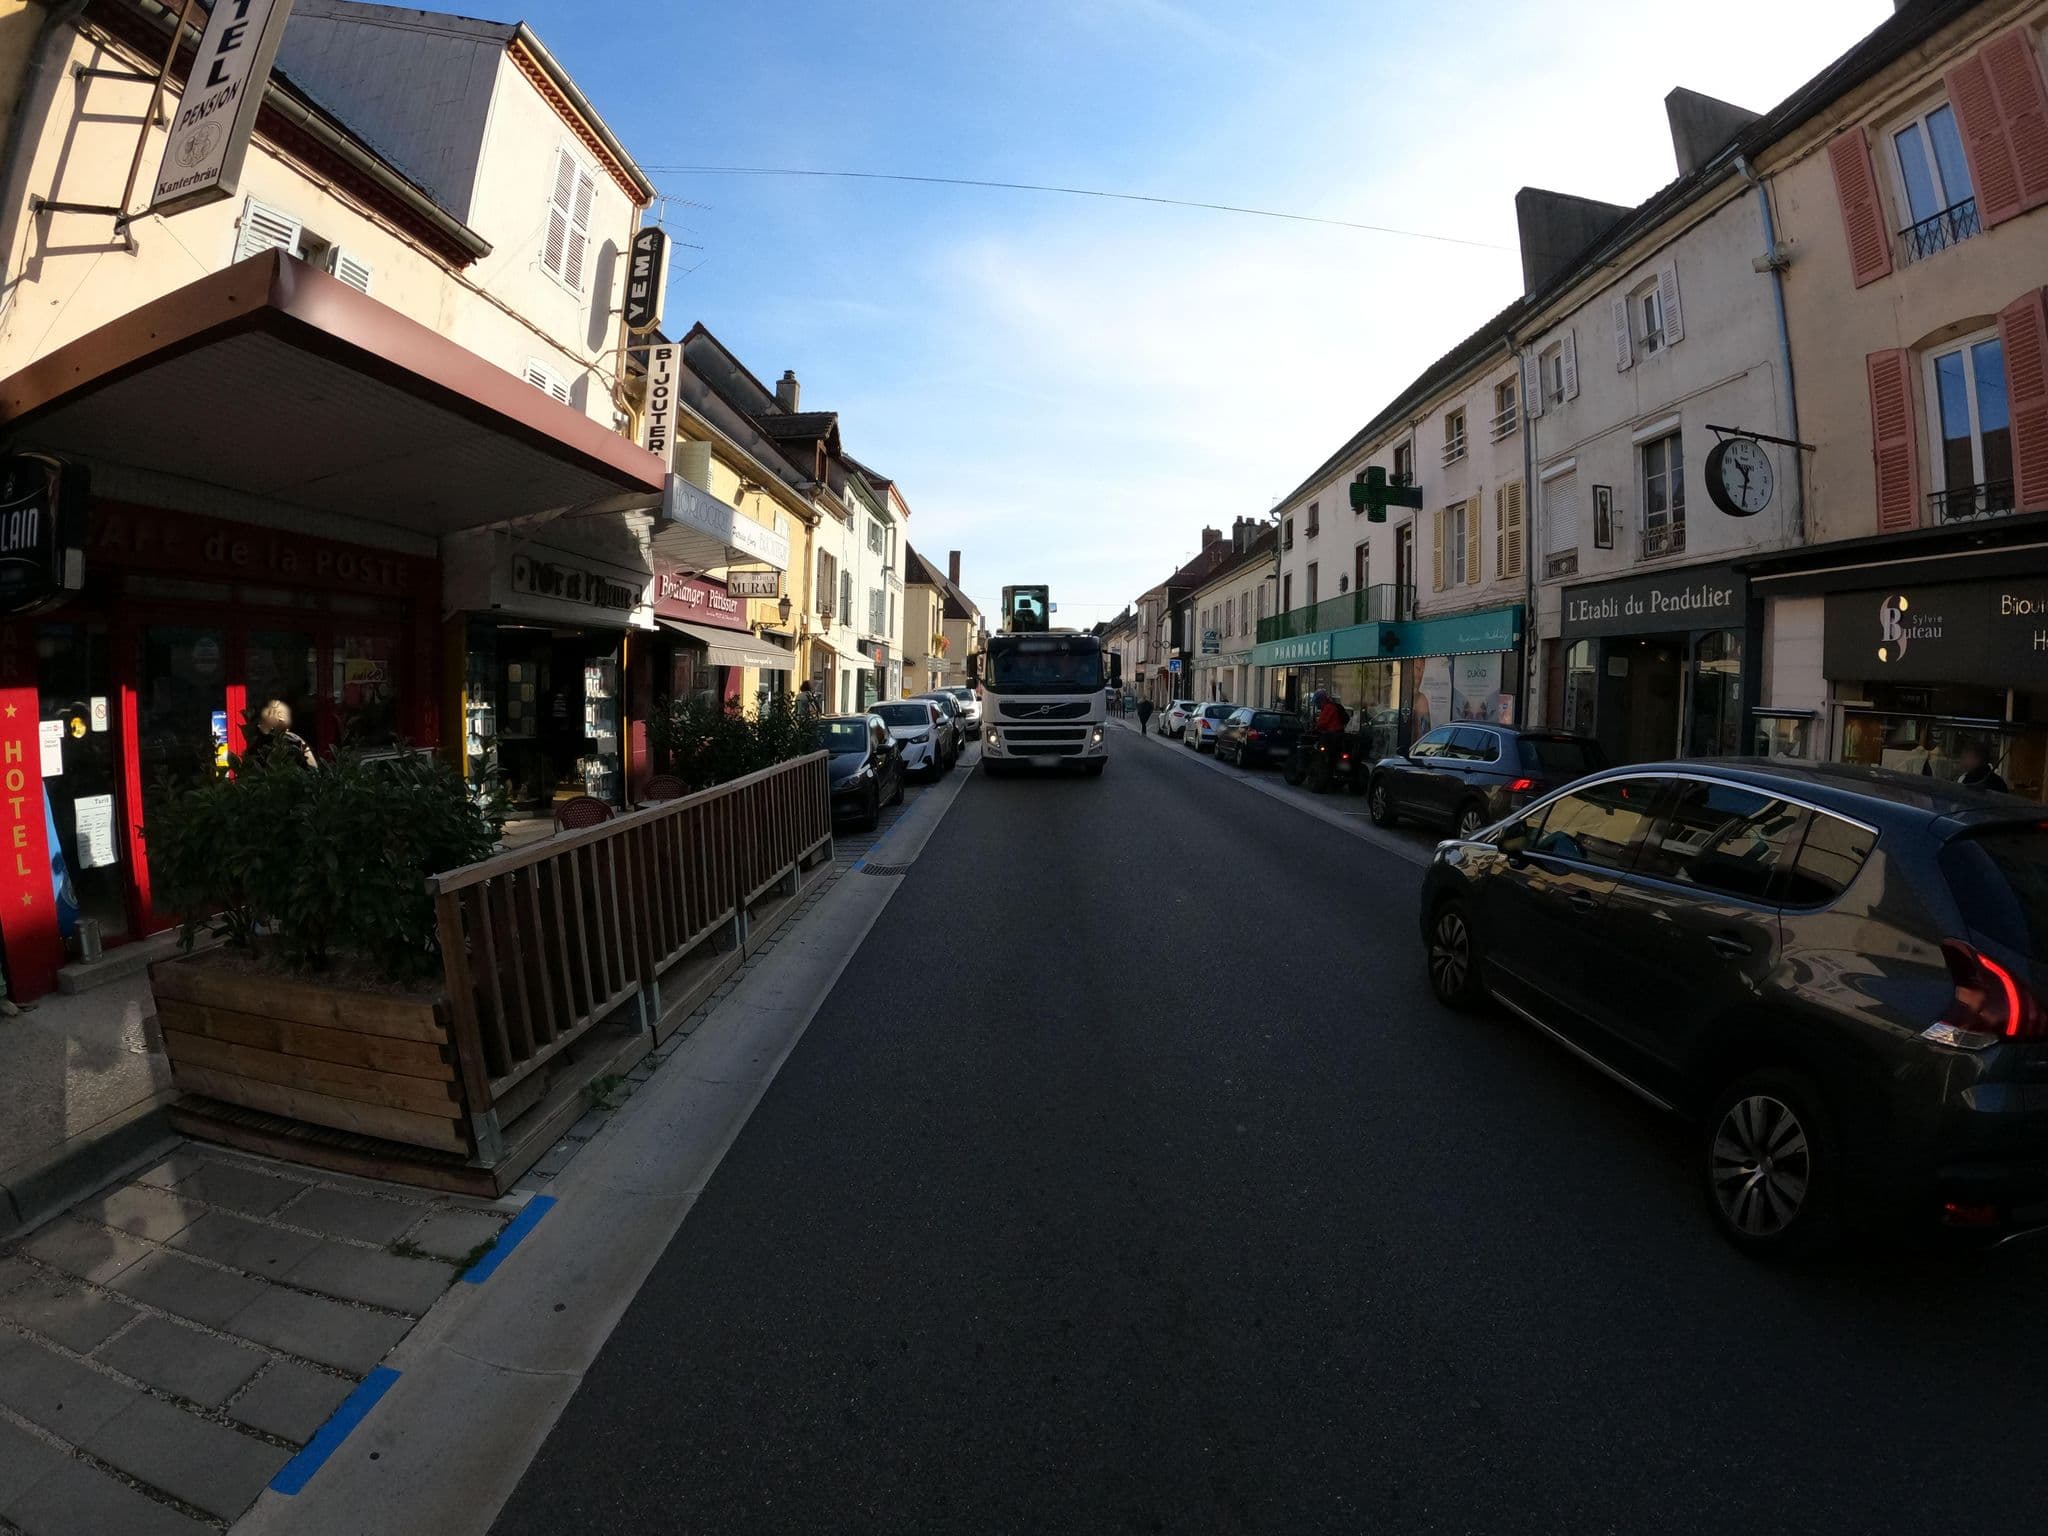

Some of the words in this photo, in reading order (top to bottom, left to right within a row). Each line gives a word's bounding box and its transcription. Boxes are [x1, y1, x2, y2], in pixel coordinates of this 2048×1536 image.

[178, 79, 242, 131] PENSION
[156, 166, 218, 196] Kanterbräu
[628, 234, 653, 321] YEMA
[648, 348, 673, 457] BIJOUTER
[204, 527, 250, 566] de
[272, 540, 298, 572] la
[316, 550, 410, 588] POSTE
[732, 582, 776, 595] MURAT
[1569, 597, 1619, 622] L'Etabli
[1625, 594, 1643, 615] du
[1651, 584, 1732, 613] Pendulier
[1881, 607, 1942, 642] Buteau
[1912, 614, 1943, 626] Sylvie
[1275, 639, 1329, 660] PHARMACIE
[4, 740, 32, 876] HOTEL
